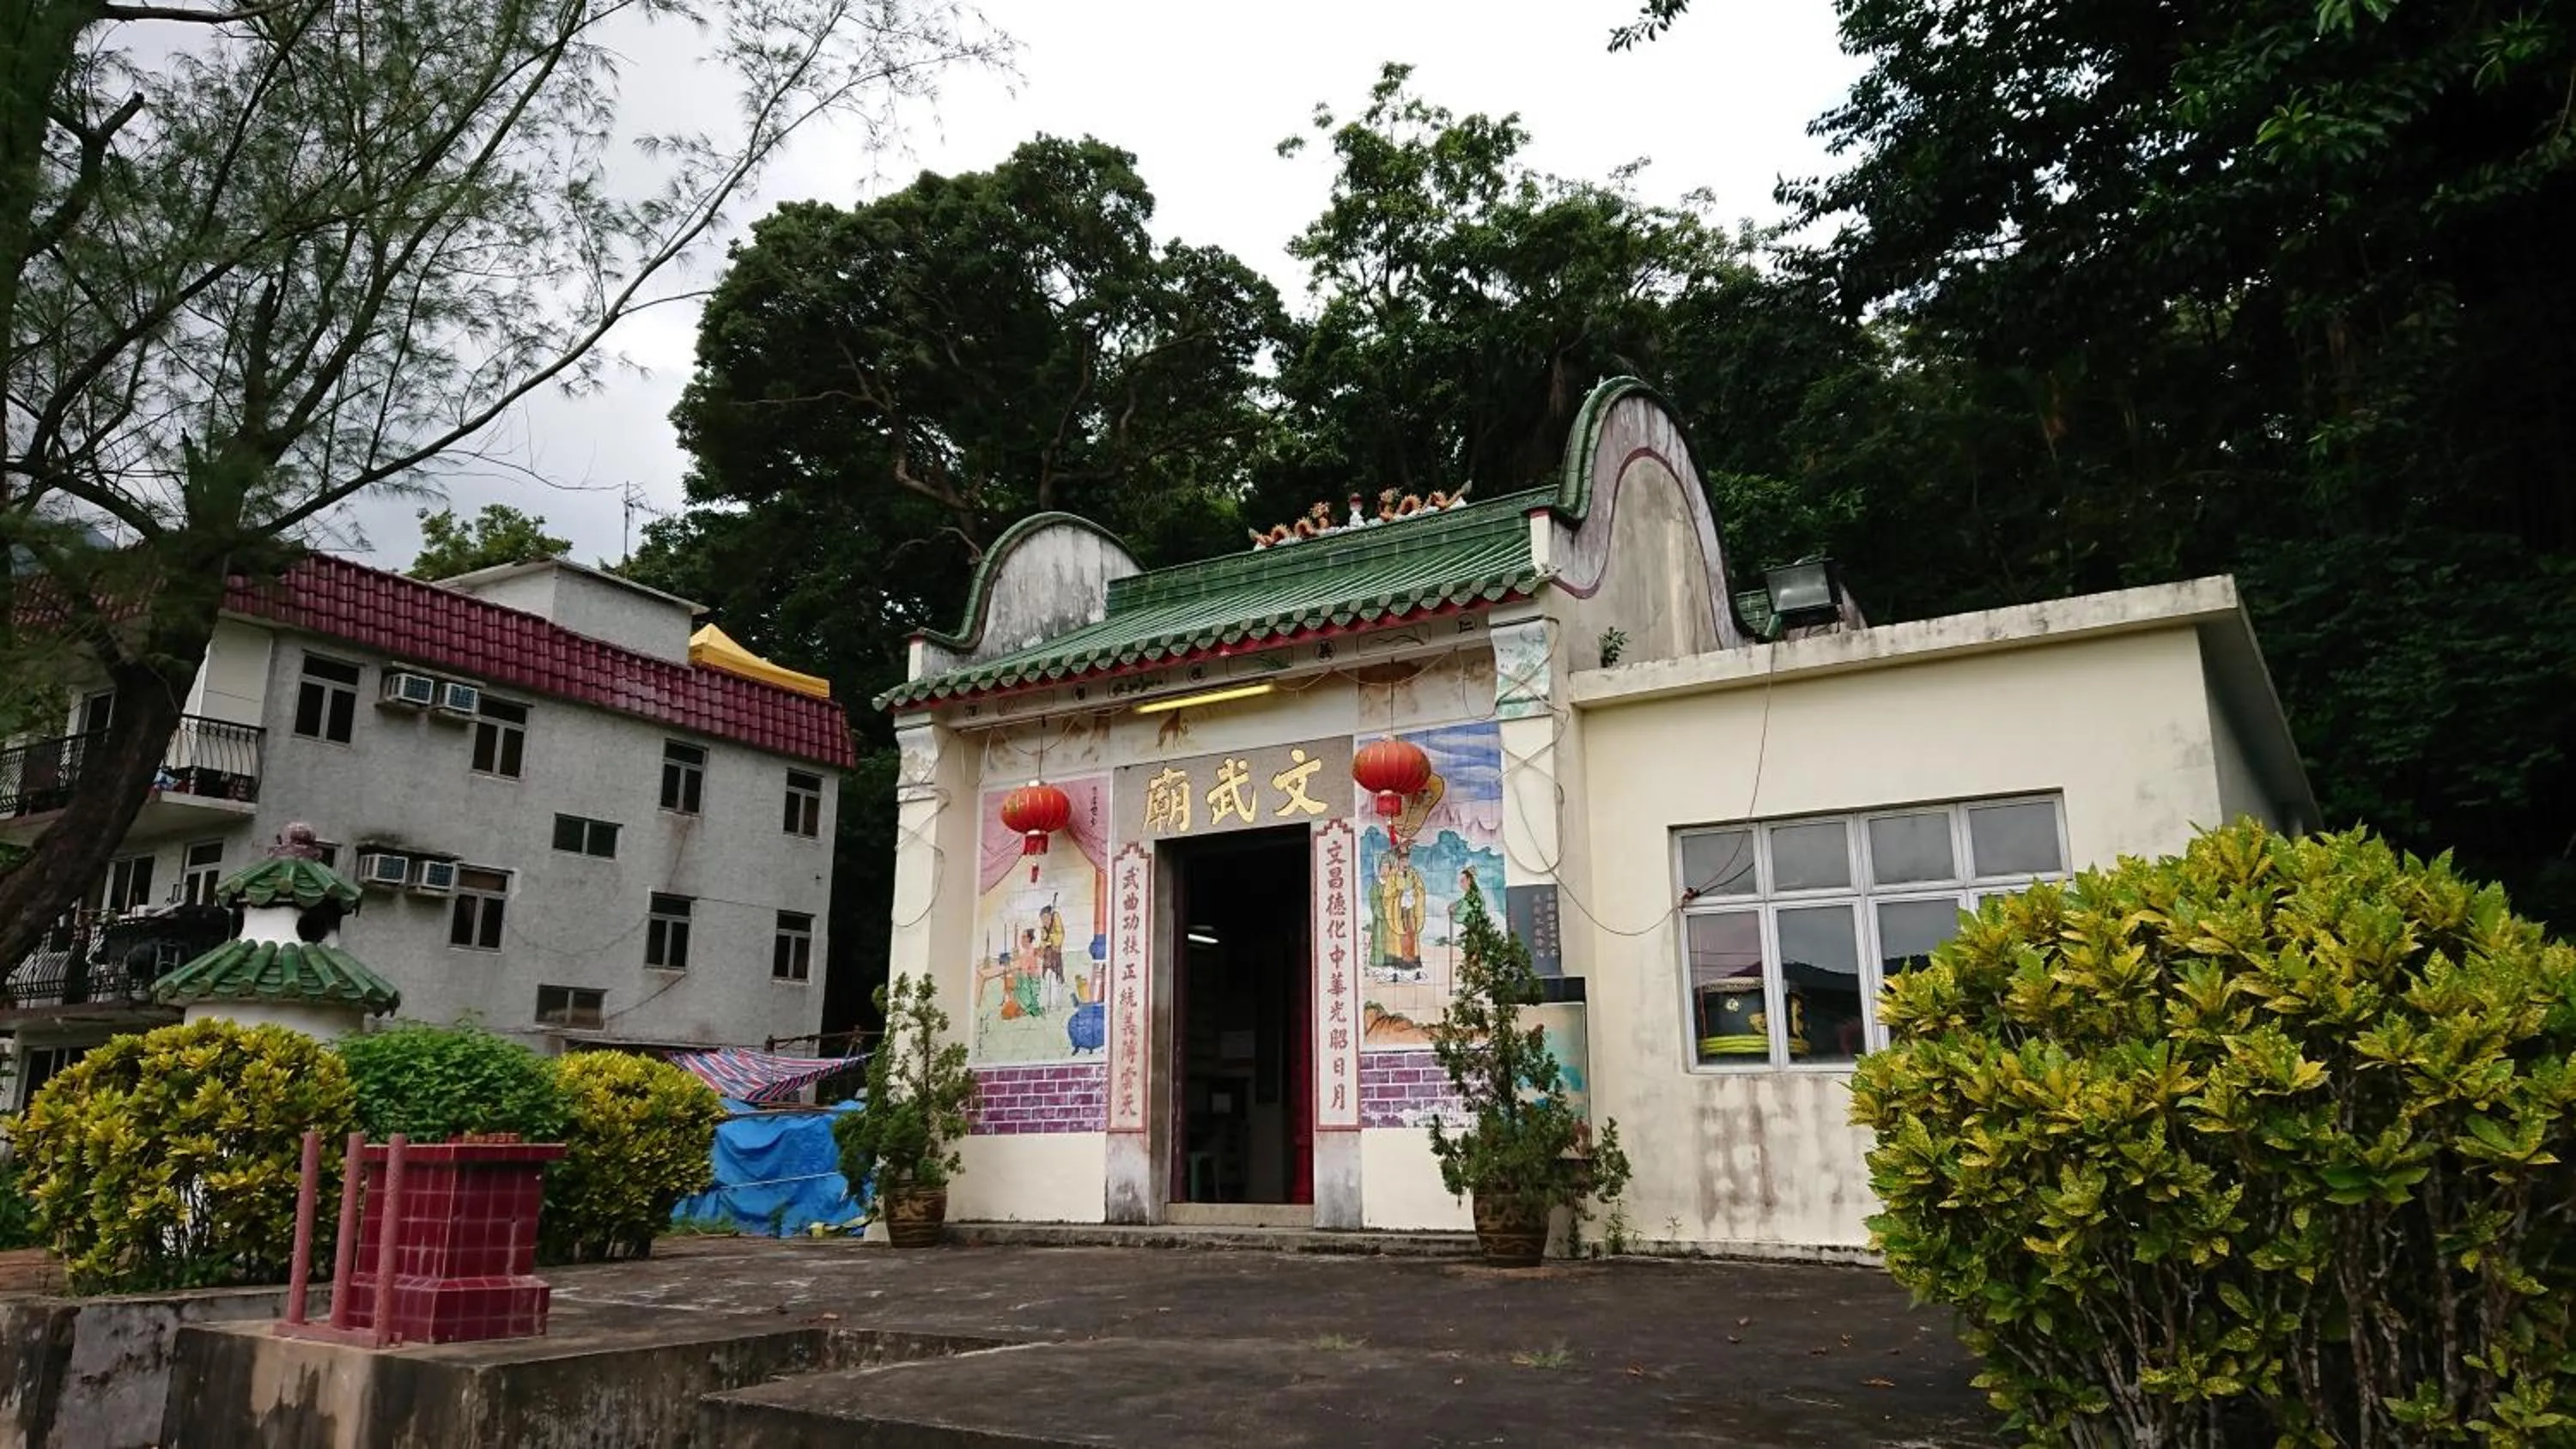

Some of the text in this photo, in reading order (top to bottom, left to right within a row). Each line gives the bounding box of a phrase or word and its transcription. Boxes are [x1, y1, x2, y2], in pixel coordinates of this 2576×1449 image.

[1325, 840, 1349, 1111] 文昌德化中華光昭日月
